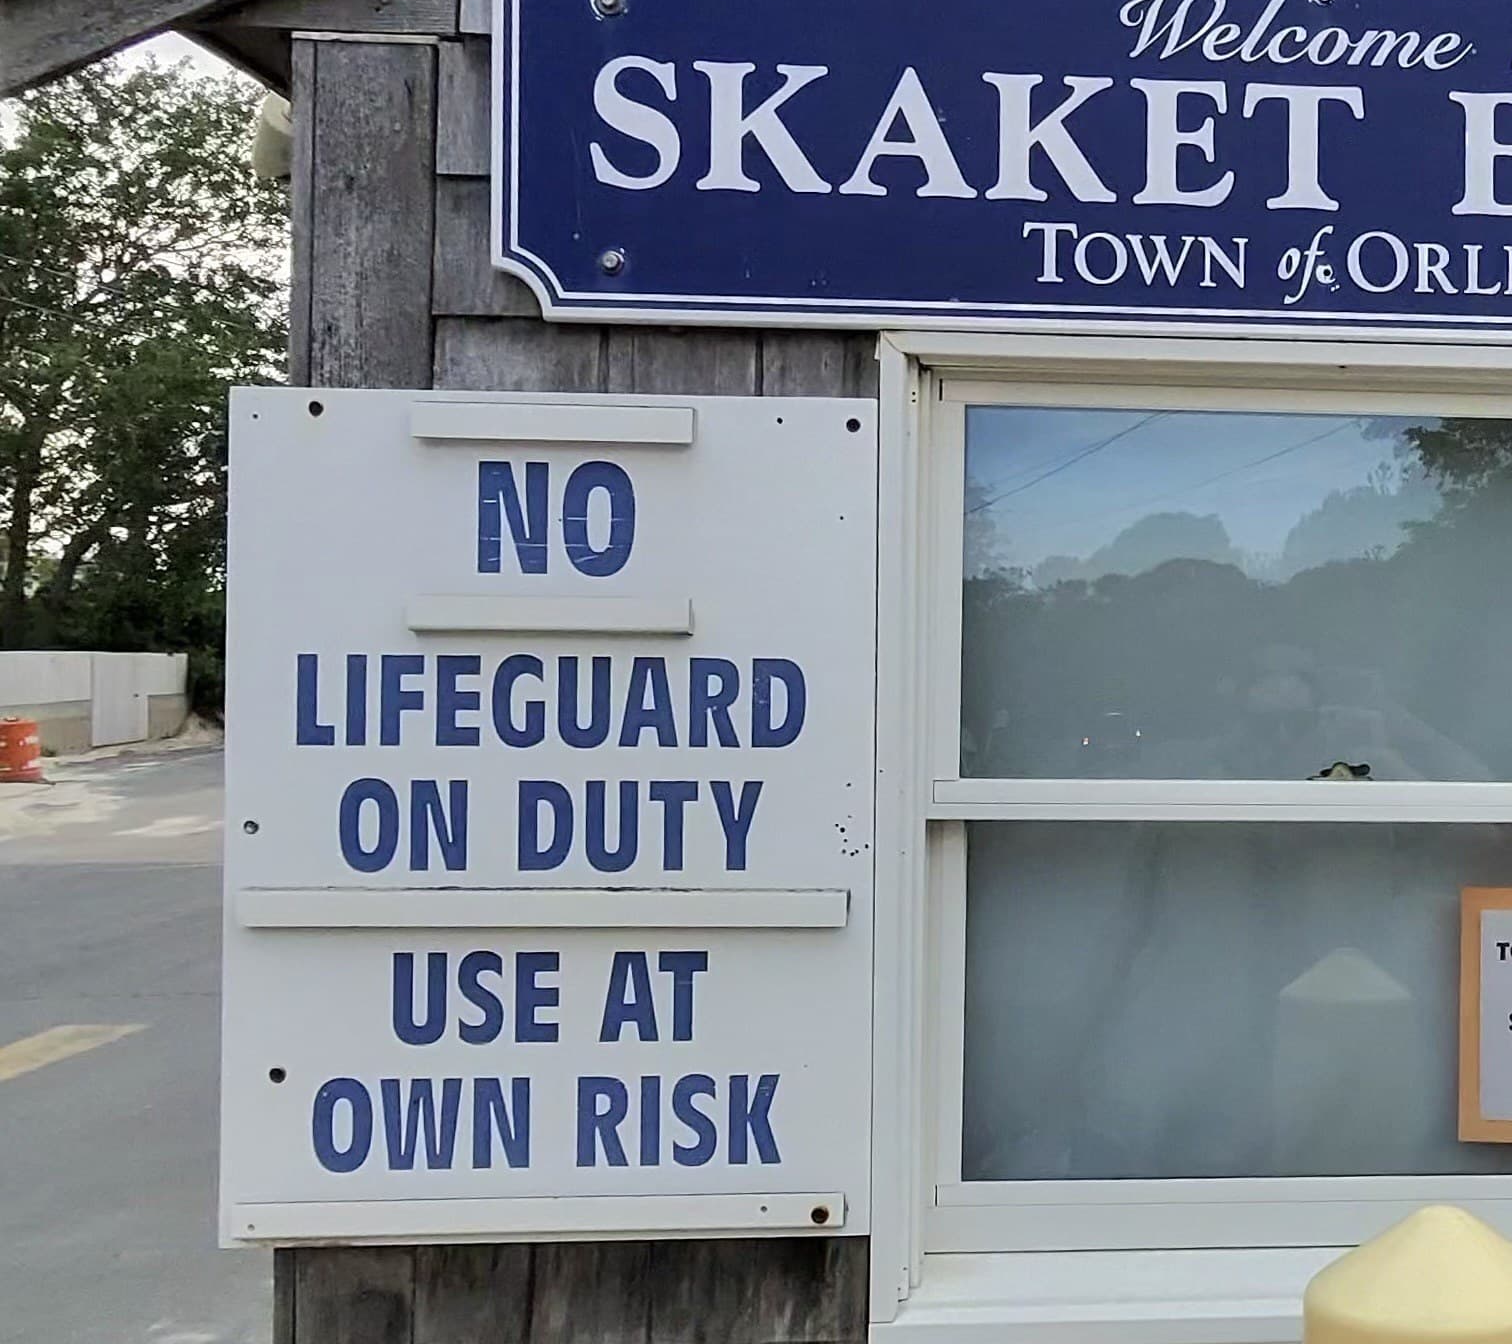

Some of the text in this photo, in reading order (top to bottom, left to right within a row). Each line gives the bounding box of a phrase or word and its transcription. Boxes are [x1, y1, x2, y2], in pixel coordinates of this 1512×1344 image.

[589, 55, 1365, 211] SKAKET
[1022, 221, 1248, 288] TOWN
[1276, 224, 1334, 305] of
[477, 460, 636, 577] NO
[296, 653, 807, 749] LIFEGUARD
[339, 777, 764, 873] ON DUTY
[393, 950, 709, 1046] USE AT
[312, 1073, 781, 1174] OWN RISK
